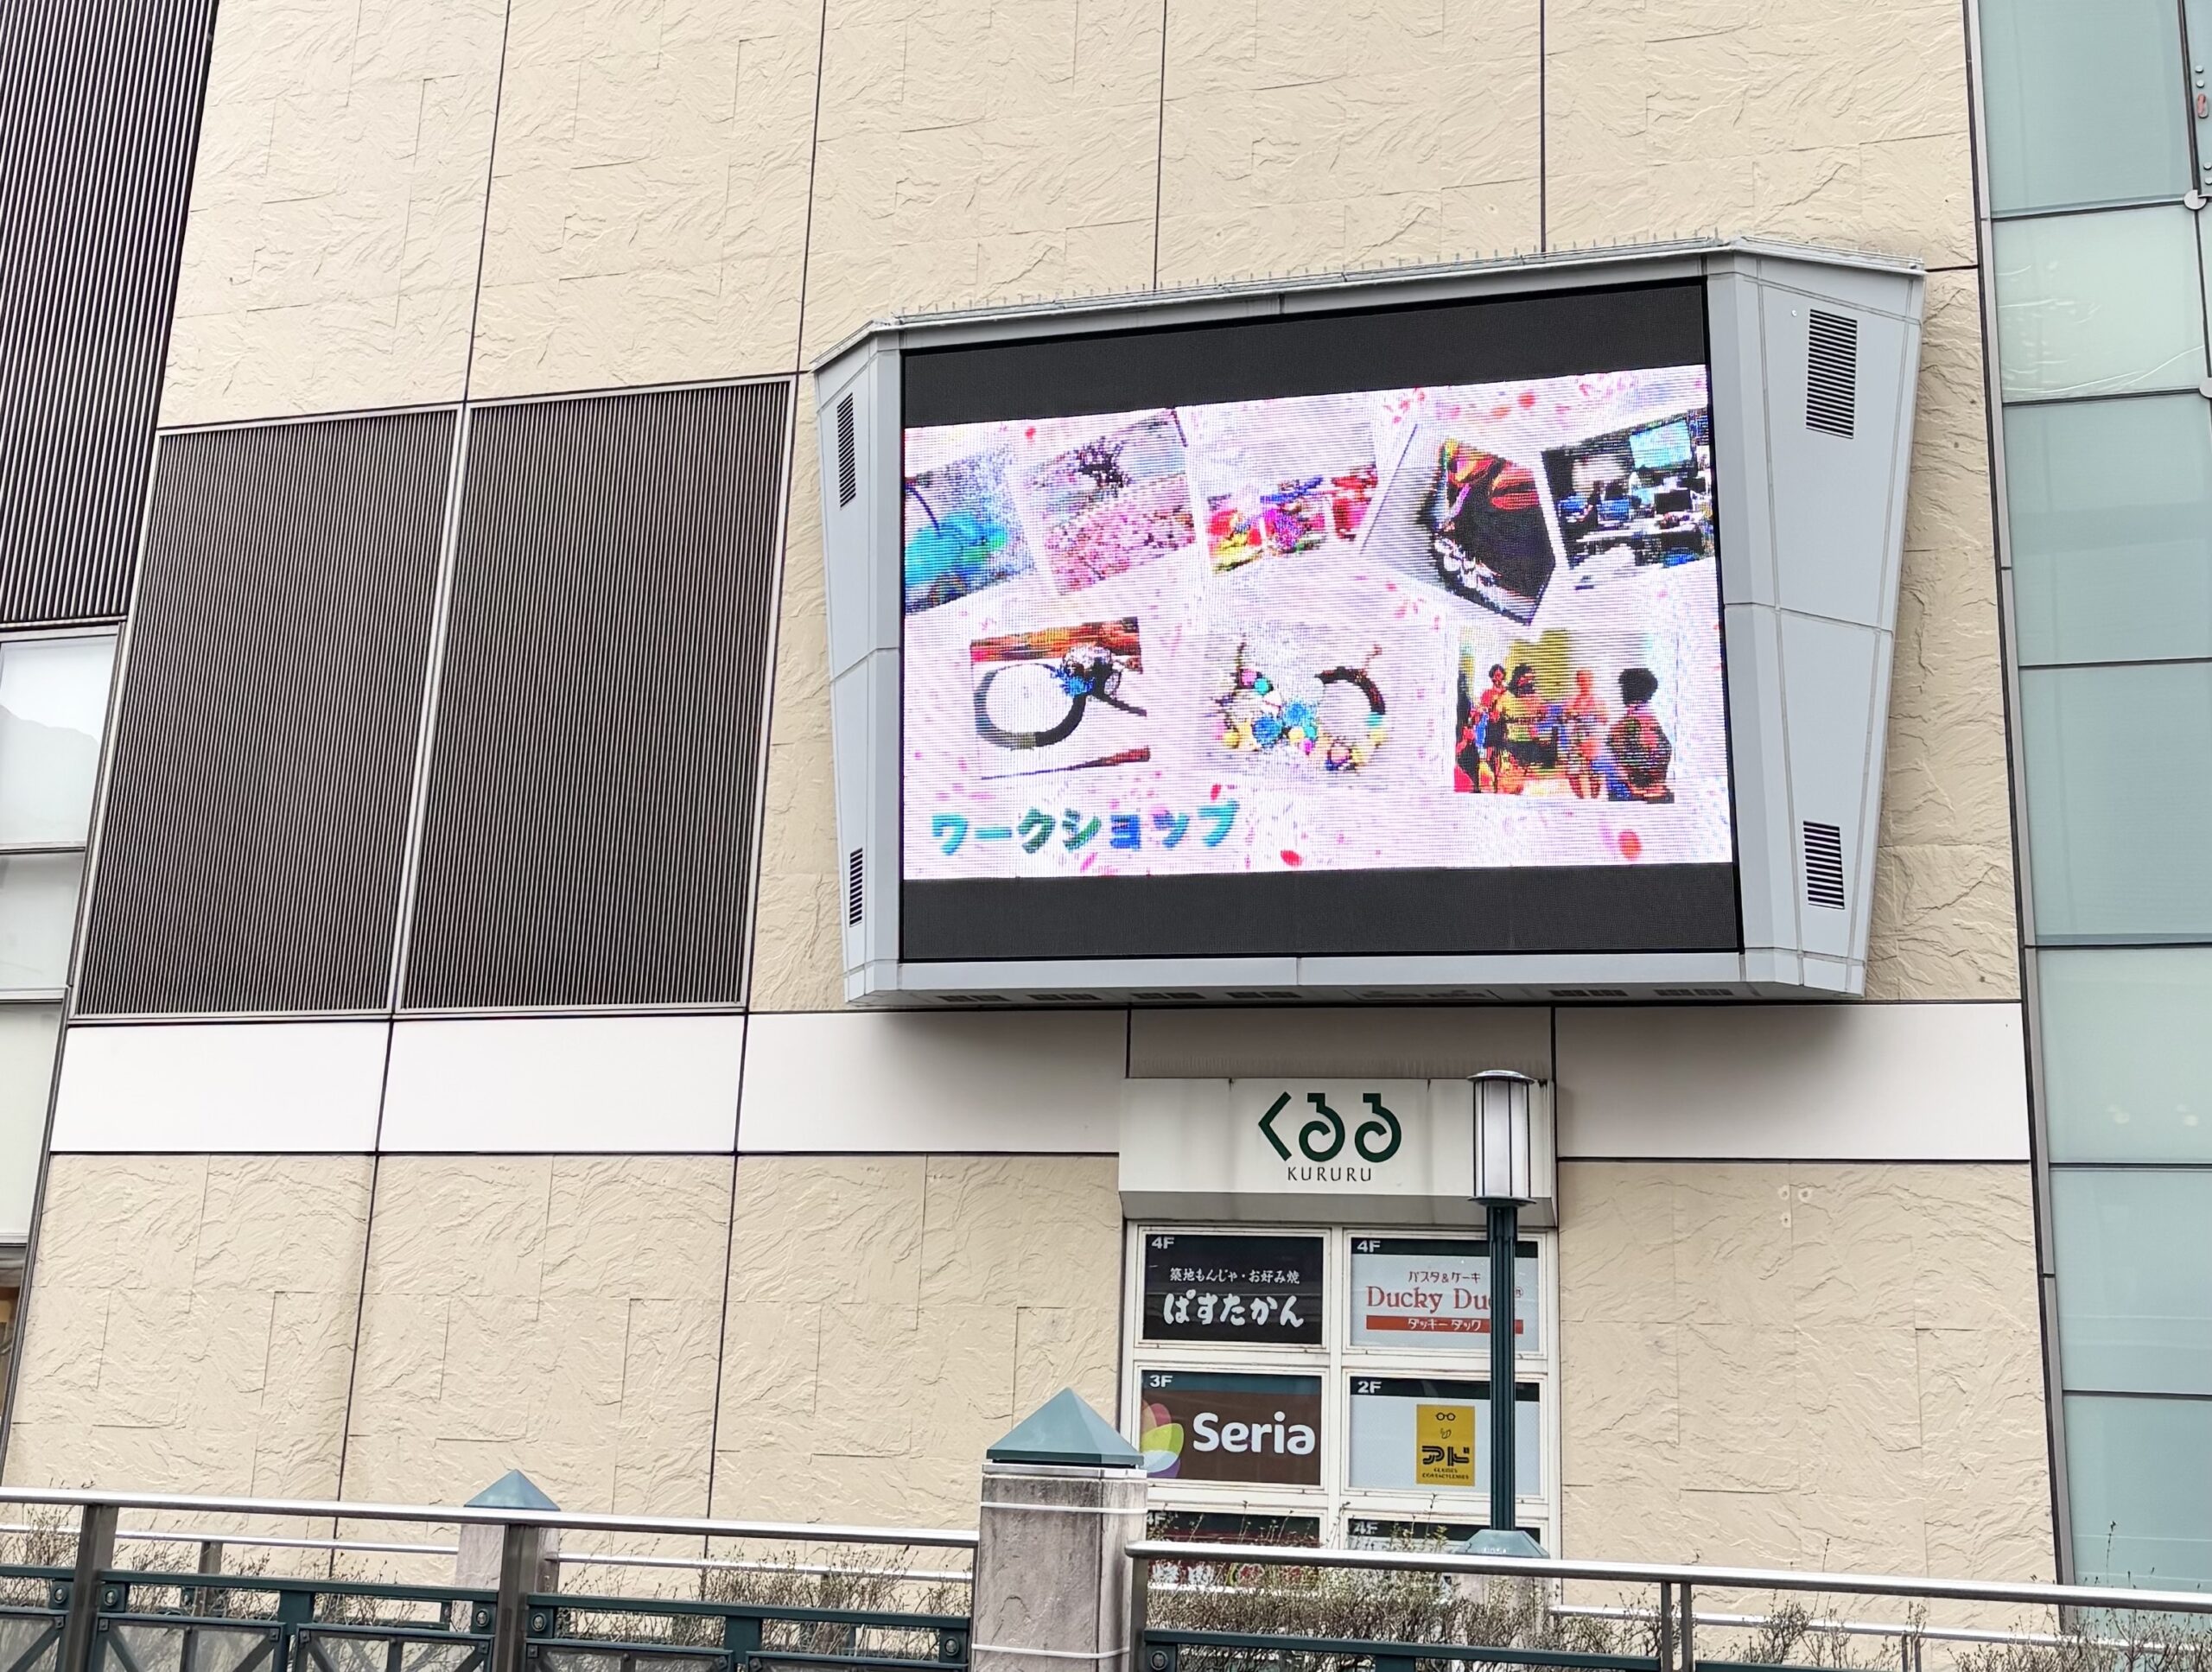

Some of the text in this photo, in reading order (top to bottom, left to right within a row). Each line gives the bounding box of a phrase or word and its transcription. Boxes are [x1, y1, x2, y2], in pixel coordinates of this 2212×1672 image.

[1258, 1091, 1402, 1163] くるる
[1287, 1167, 1371, 1182] KURURU
[1151, 1237, 1175, 1249] 4F
[1357, 1240, 1381, 1253] 4F
[1366, 1286, 1443, 1313] Ducky
[1163, 1289, 1304, 1328] ぱすたかん
[1149, 1375, 1173, 1388] 3F
[1357, 1381, 1382, 1394] 2F
[1192, 1411, 1316, 1455] Seria
